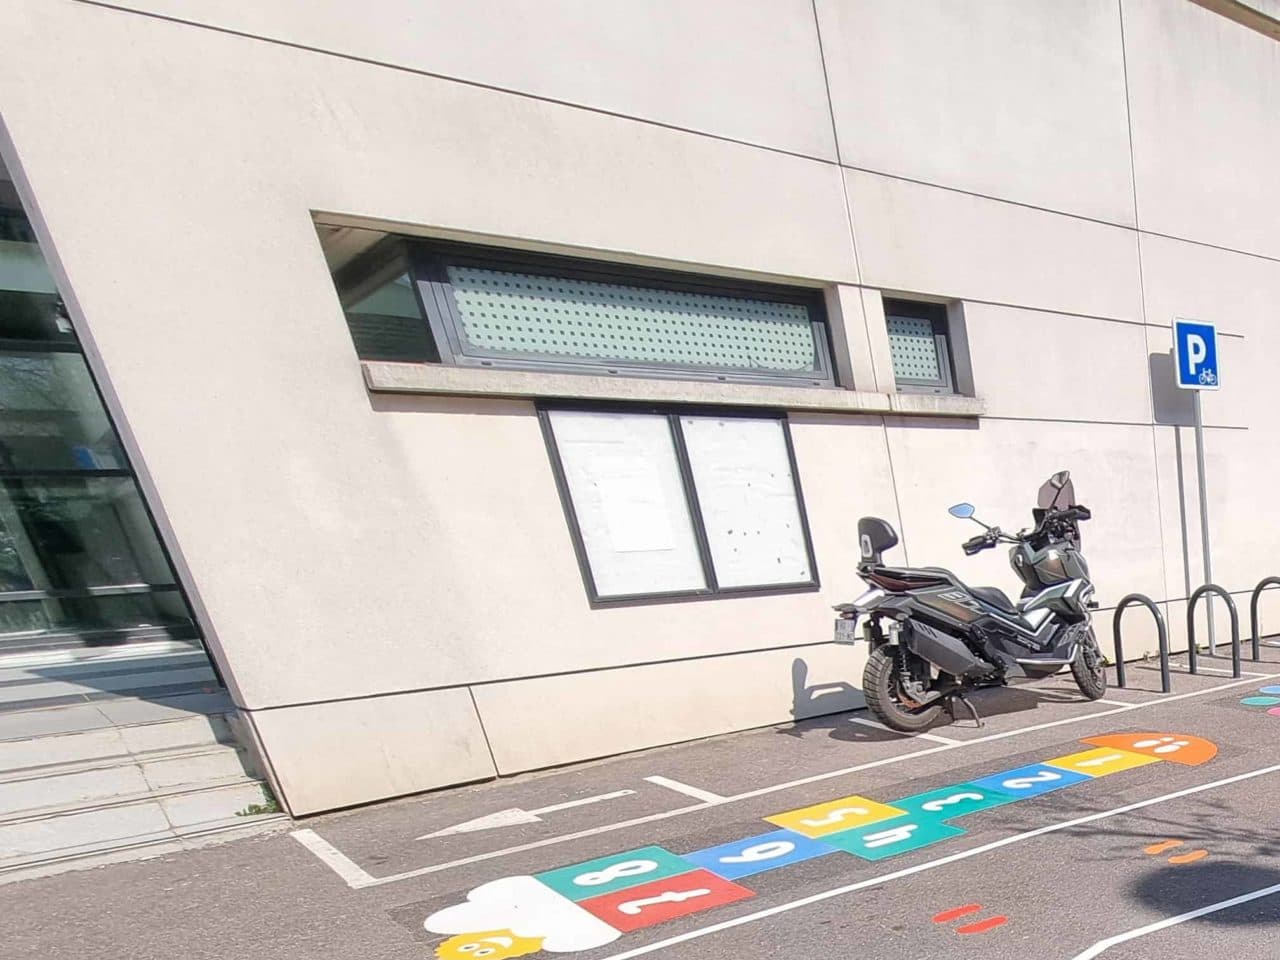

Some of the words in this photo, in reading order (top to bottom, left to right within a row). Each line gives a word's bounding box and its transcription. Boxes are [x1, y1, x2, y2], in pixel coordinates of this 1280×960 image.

[1186, 333, 1207, 375] P
[1074, 753, 1123, 768] 1
[1002, 771, 1062, 789] 2
[921, 792, 984, 811] 3
[802, 806, 869, 827] 5
[862, 823, 919, 848] 4
[719, 840, 796, 864] 6
[573, 860, 658, 886] 8
[617, 888, 712, 915] 7
